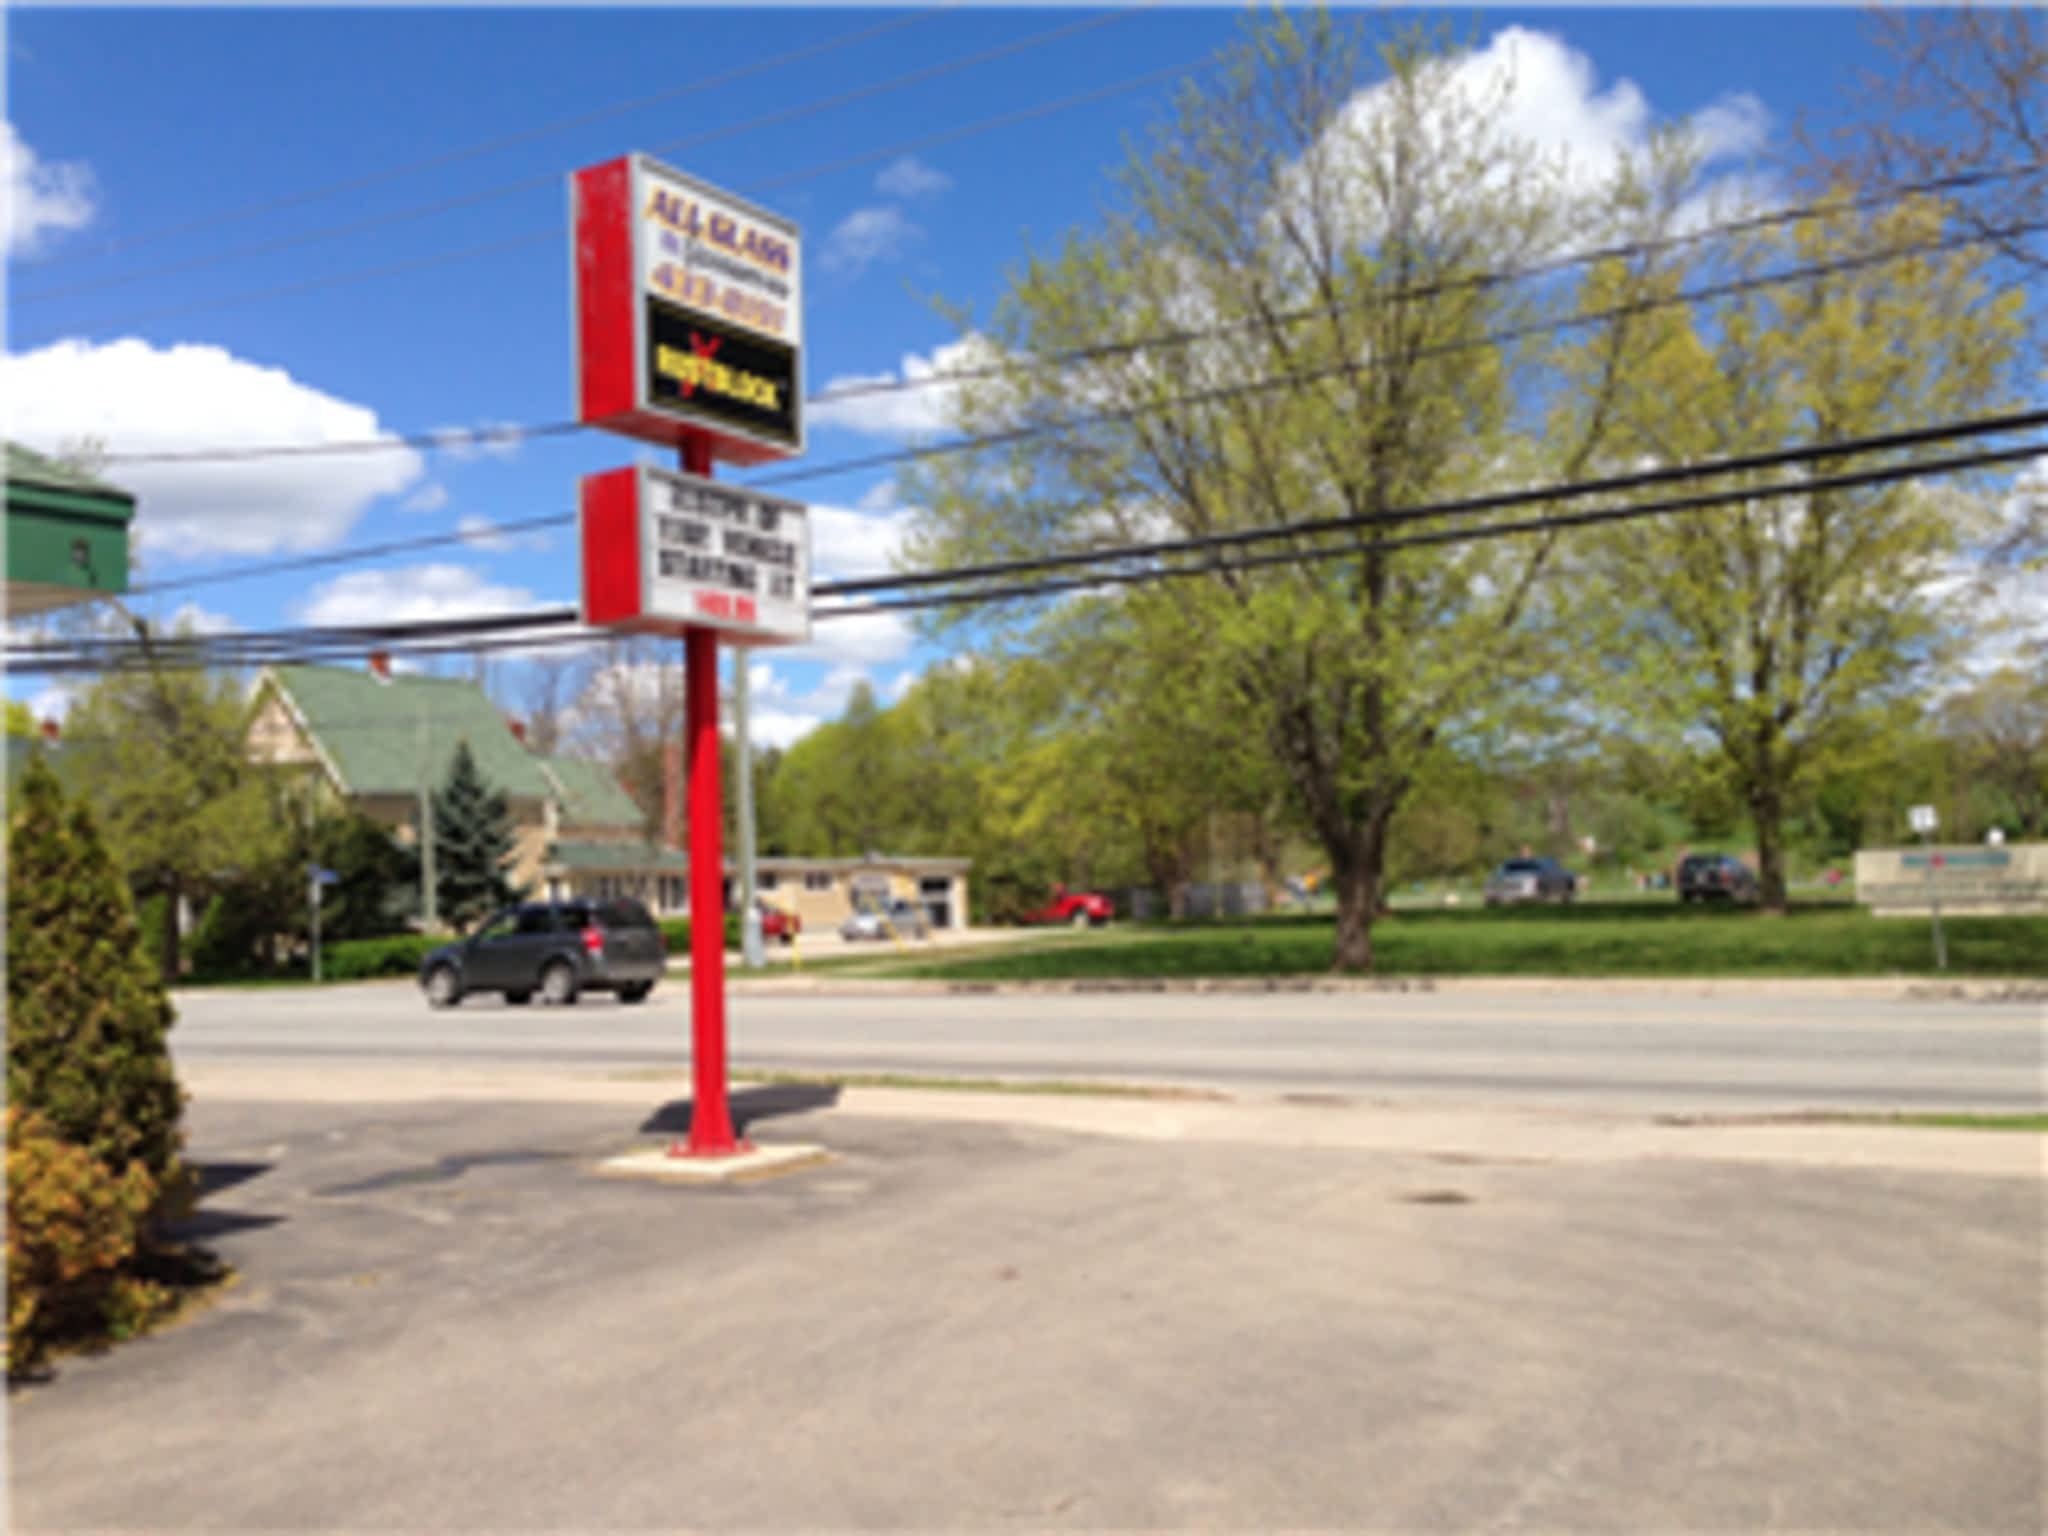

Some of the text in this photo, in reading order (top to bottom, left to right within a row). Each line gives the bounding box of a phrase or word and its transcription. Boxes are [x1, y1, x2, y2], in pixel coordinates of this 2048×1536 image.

[643, 186, 702, 238] ALL
[706, 210, 791, 275] GLASS
[658, 549, 756, 591] STARTING
